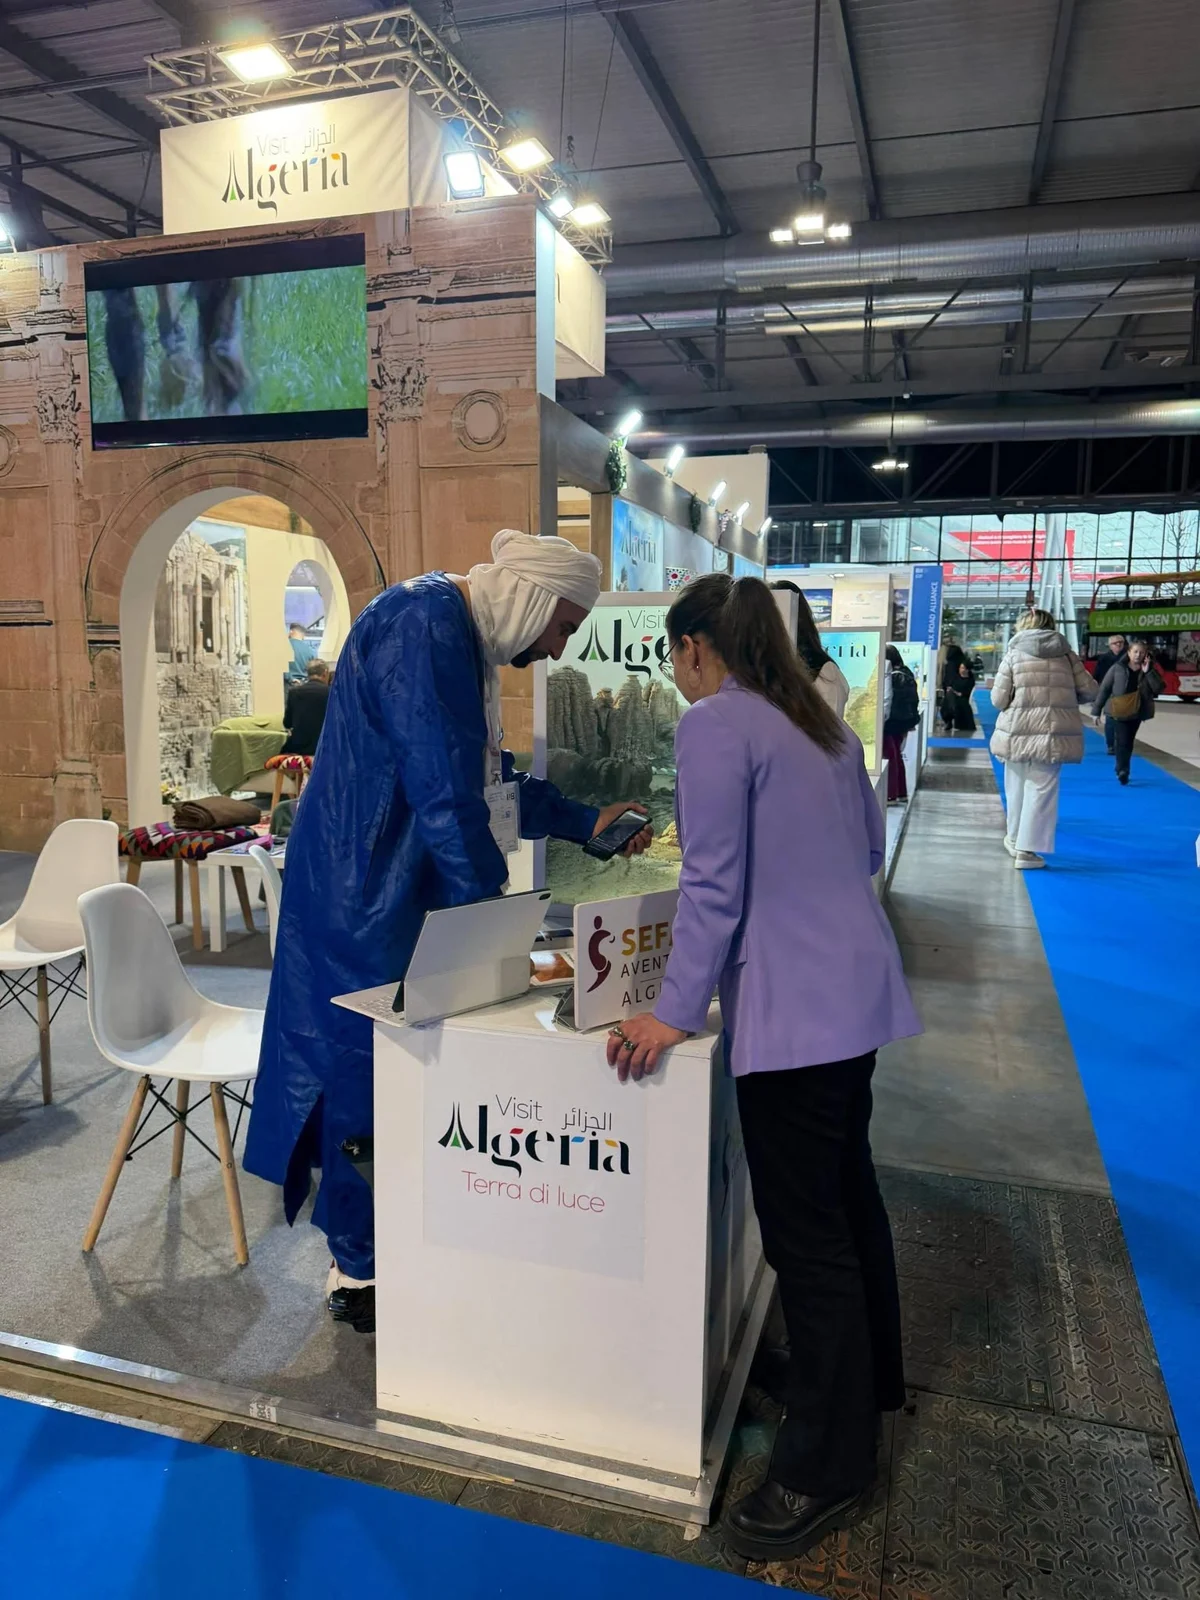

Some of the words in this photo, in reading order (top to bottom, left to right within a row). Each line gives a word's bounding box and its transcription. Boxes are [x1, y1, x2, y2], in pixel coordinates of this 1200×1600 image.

[221, 147, 350, 218] Algeria
[930, 581, 938, 612] ALLIANCE
[627, 609, 667, 629] Visit
[1106, 616, 1137, 628] MILAN
[1138, 614, 1169, 627] OPEN
[577, 618, 670, 680] Alge
[621, 921, 673, 956] SEF
[620, 953, 670, 978] AVENT
[621, 982, 662, 1007] ALG
[495, 1094, 543, 1122] Visit
[561, 1107, 612, 1133] الجزائر
[437, 1101, 631, 1179] Algeria
[461, 1170, 522, 1200] Terra
[529, 1183, 549, 1205] di
[557, 1186, 605, 1213] luce
